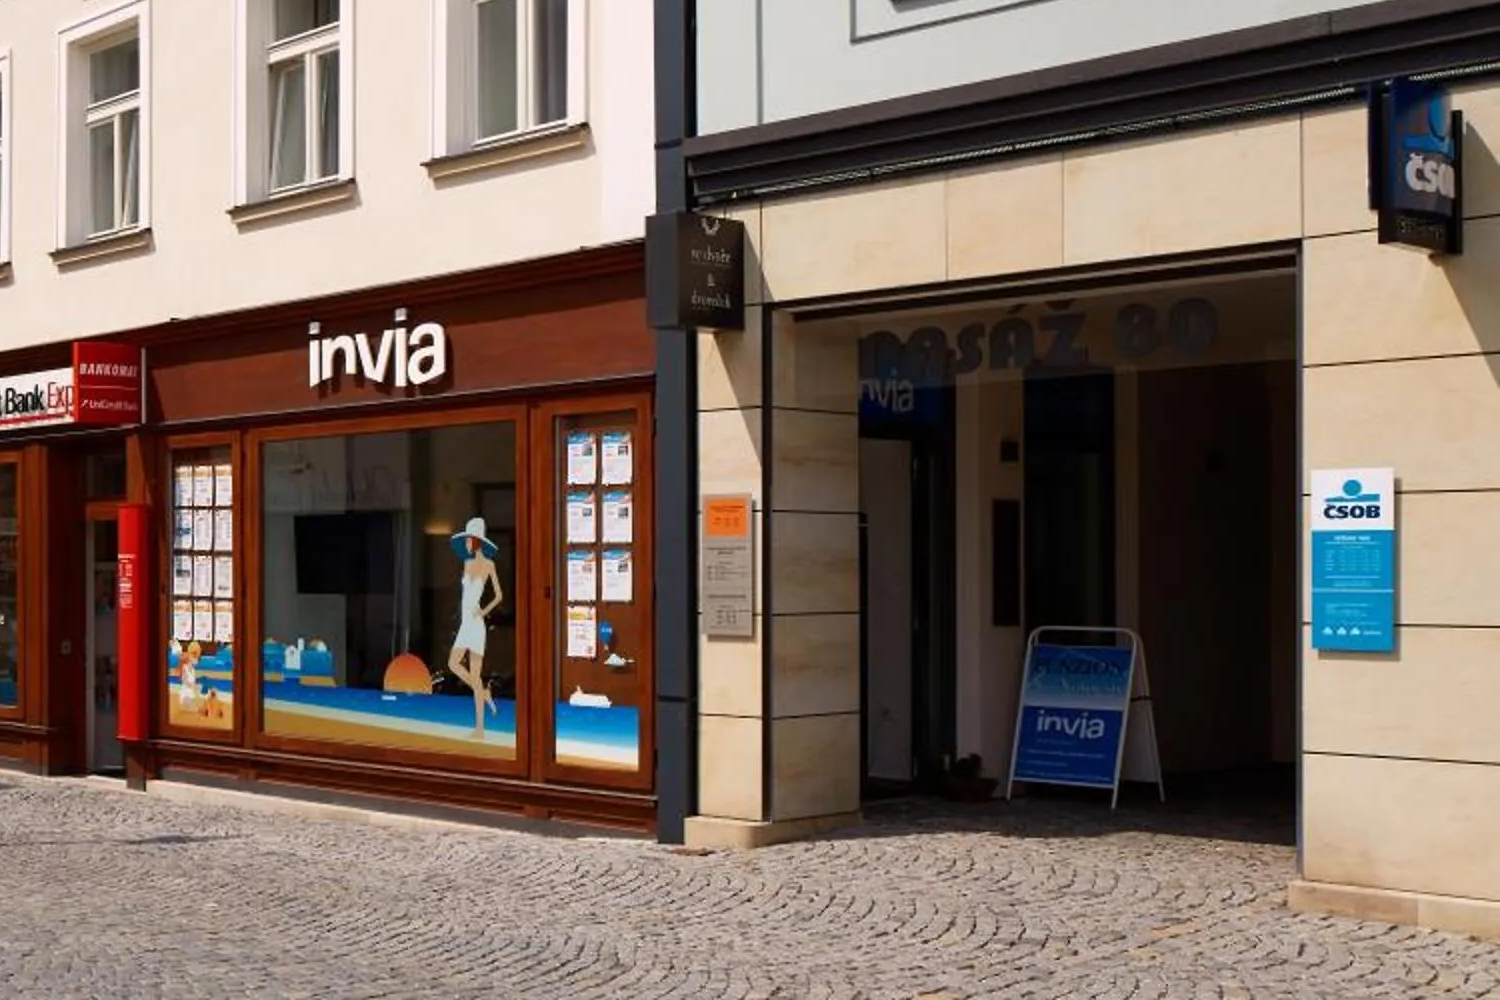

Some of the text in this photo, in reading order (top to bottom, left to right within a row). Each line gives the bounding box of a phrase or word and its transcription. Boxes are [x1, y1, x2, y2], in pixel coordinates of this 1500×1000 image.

[1405, 152, 1456, 200] ČSO
[308, 307, 446, 388] invia
[5, 383, 45, 414] Bank
[47, 381, 75, 414] Exp
[859, 365, 914, 413] nvia
[1323, 503, 1381, 520] ČSOB
[1036, 708, 1106, 740] invia
